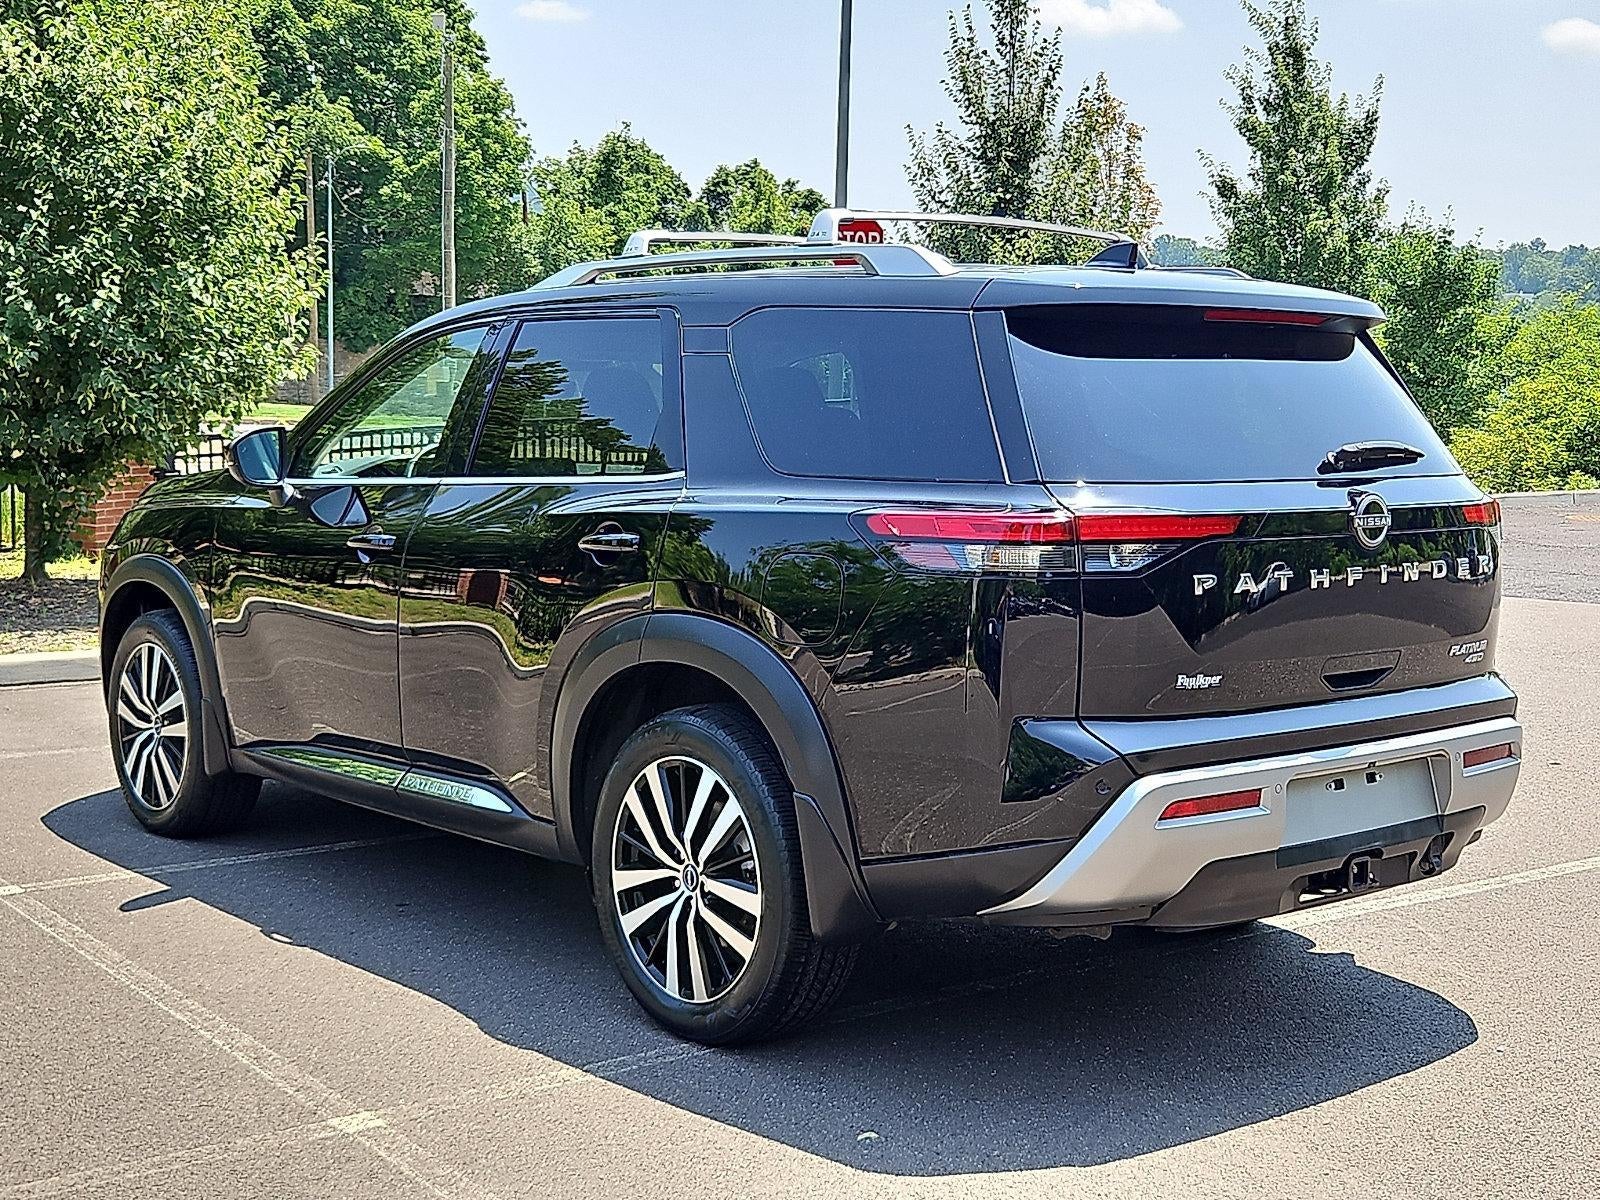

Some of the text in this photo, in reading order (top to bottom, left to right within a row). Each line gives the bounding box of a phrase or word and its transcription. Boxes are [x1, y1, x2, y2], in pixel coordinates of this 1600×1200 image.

[837, 230, 881, 244] TOP
[1354, 516, 1392, 527] NISSAN
[1193, 554, 1493, 596] PATHFINDER
